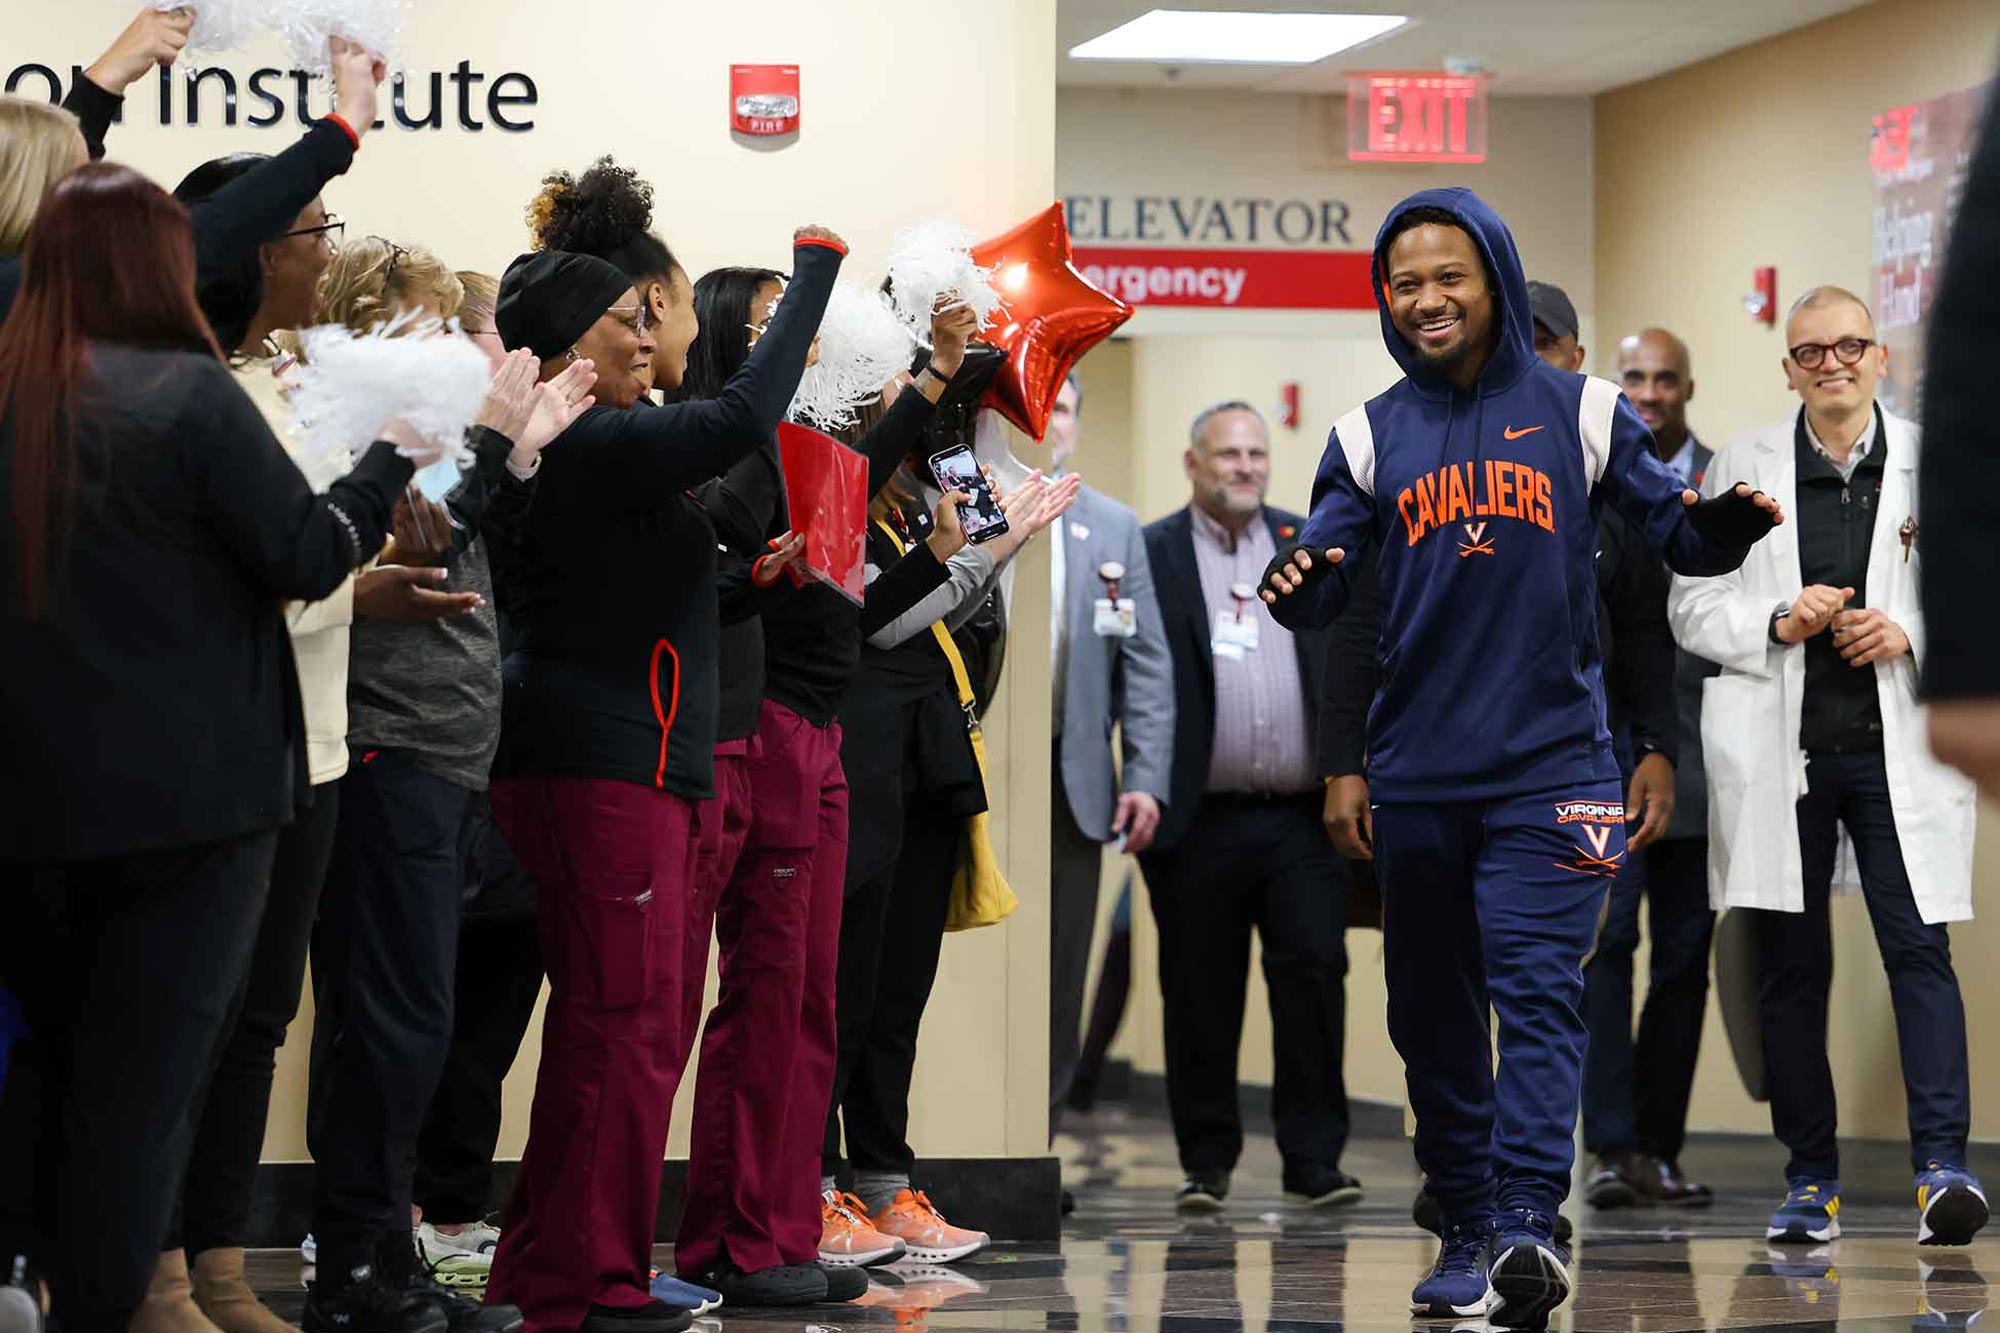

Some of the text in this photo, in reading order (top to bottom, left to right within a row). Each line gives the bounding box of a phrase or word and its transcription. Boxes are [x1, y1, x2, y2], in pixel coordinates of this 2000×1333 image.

[160, 60, 539, 131] Instute
[1369, 78, 1475, 152] EXIT
[750, 119, 784, 132] FIRE
[1065, 196, 1351, 243] ELEVATOR
[1397, 460, 1556, 548] CAVALIERS
[1555, 804, 1624, 816] VIRGINIA
